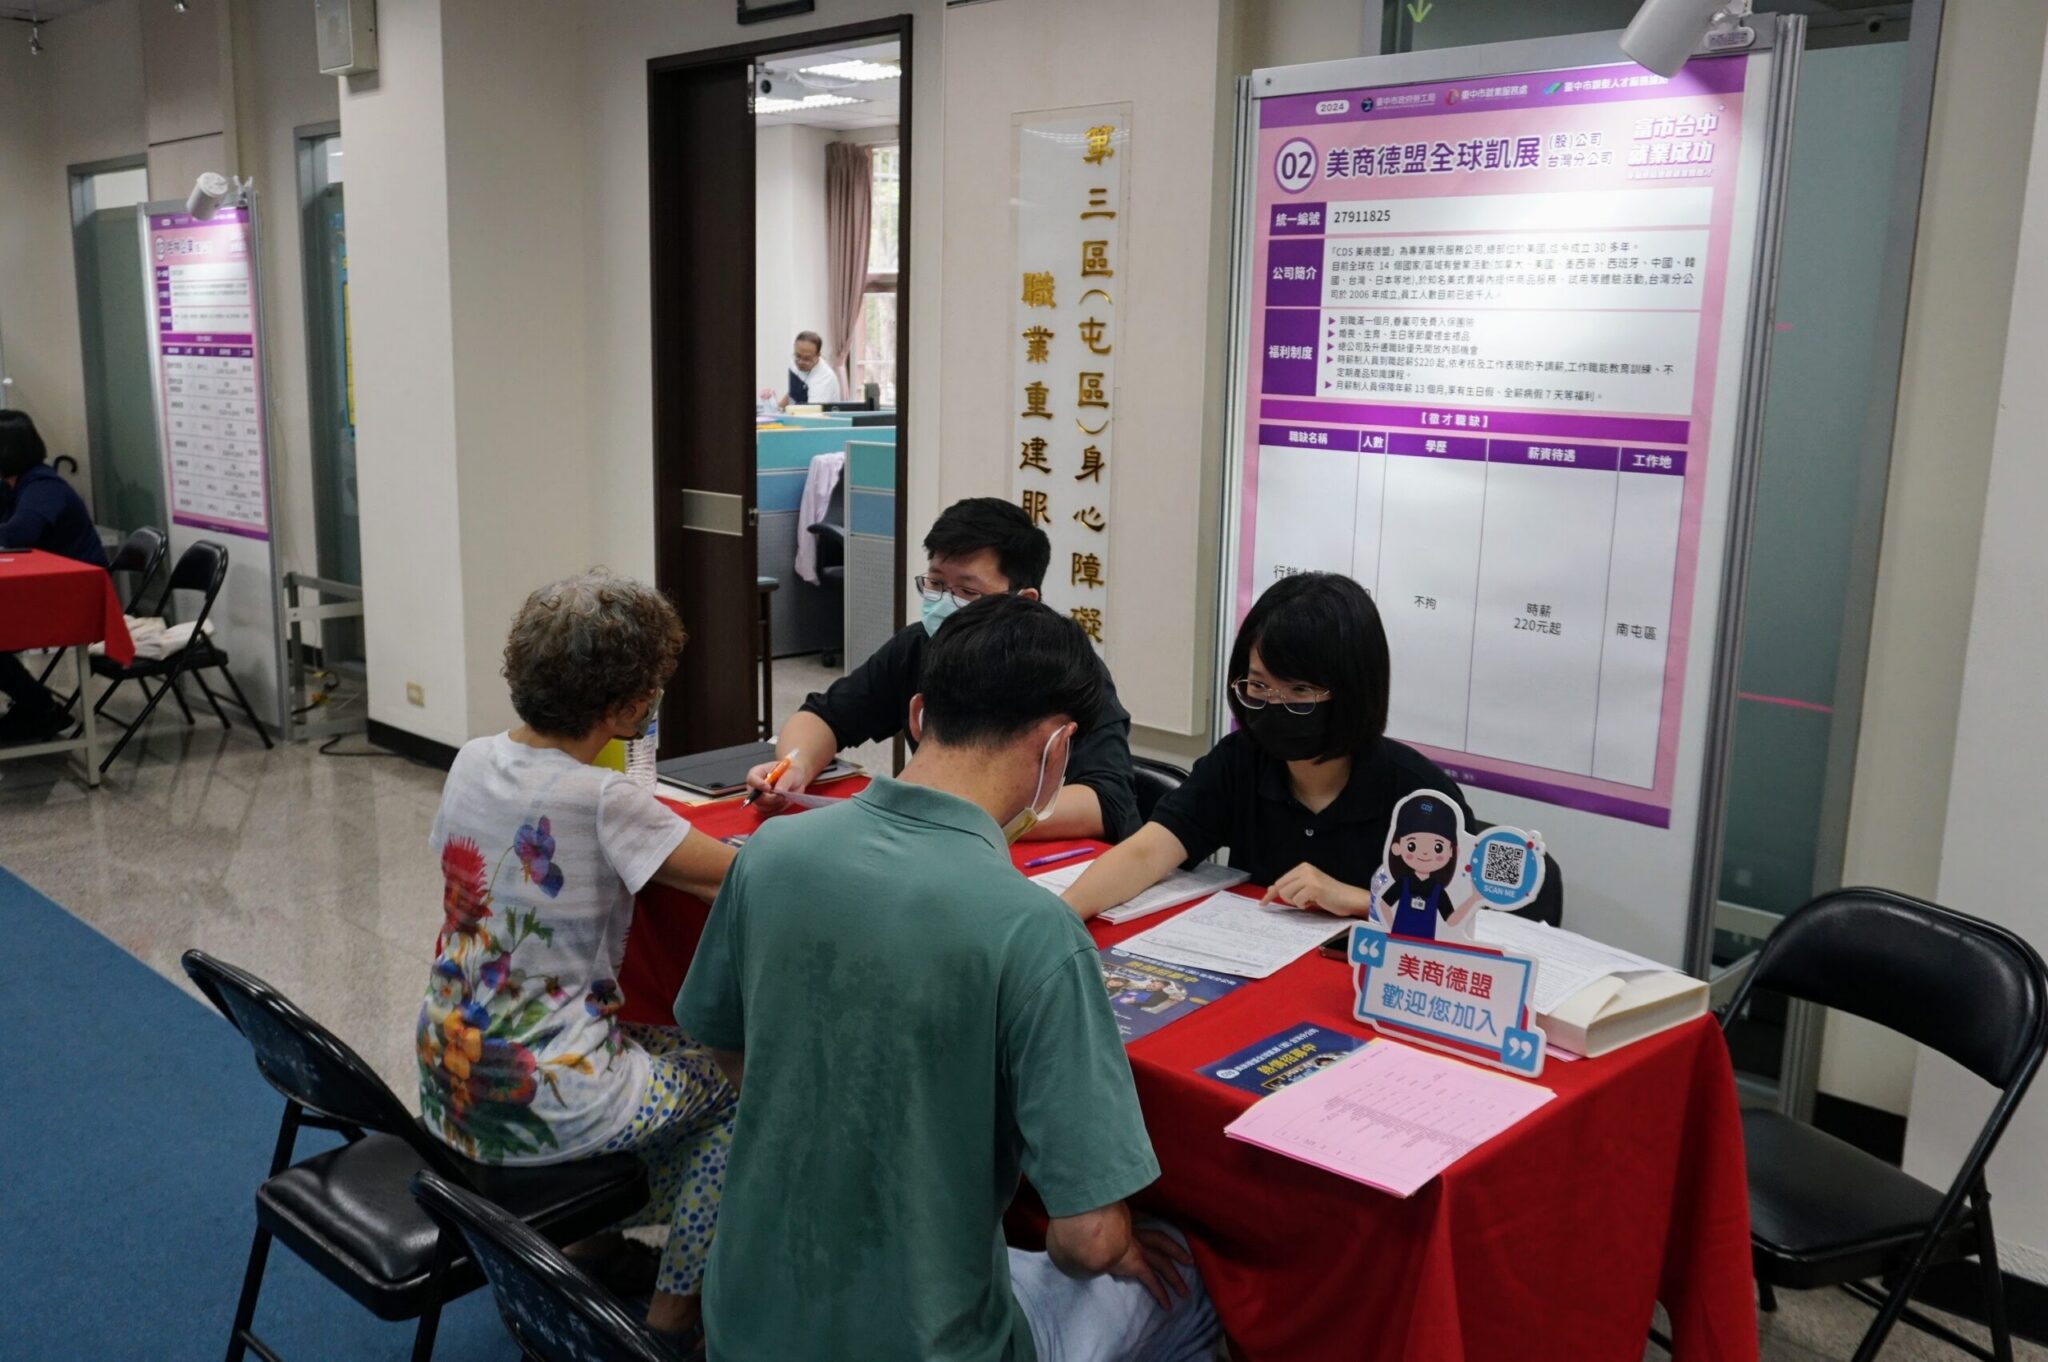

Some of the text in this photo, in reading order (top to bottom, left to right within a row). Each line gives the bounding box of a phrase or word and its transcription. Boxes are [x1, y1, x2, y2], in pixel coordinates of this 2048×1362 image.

[1320, 102, 1345, 113] 2024
[1326, 137, 1541, 178] 美商德盟全球凱展
[1548, 152, 1613, 168] 台灣分公司
[1281, 152, 1313, 180] 02
[1275, 212, 1321, 227] 統一編號
[1334, 210, 1391, 224] 27911825
[1272, 266, 1318, 281] 公司簡介
[1349, 289, 1370, 299] 2006
[1268, 345, 1314, 360] 福利制度
[1415, 384, 1424, 394] 13
[1019, 271, 1057, 526] 職業重建服
[1288, 430, 1328, 445] 職缺名稱
[1362, 435, 1384, 449] 人數
[1425, 440, 1448, 454] 學歷
[1528, 446, 1576, 463] 薪資待遇
[1632, 454, 1672, 469] 工作地
[1413, 595, 1437, 610] 不拘
[1526, 602, 1552, 618] 時薪
[1513, 617, 1562, 636] 220元起
[1616, 622, 1657, 641] 南屯區
[1484, 885, 1516, 898] SCAN ME
[1397, 952, 1493, 1000] 美商德盟
[1381, 983, 1498, 1037] 歡迎您加入
